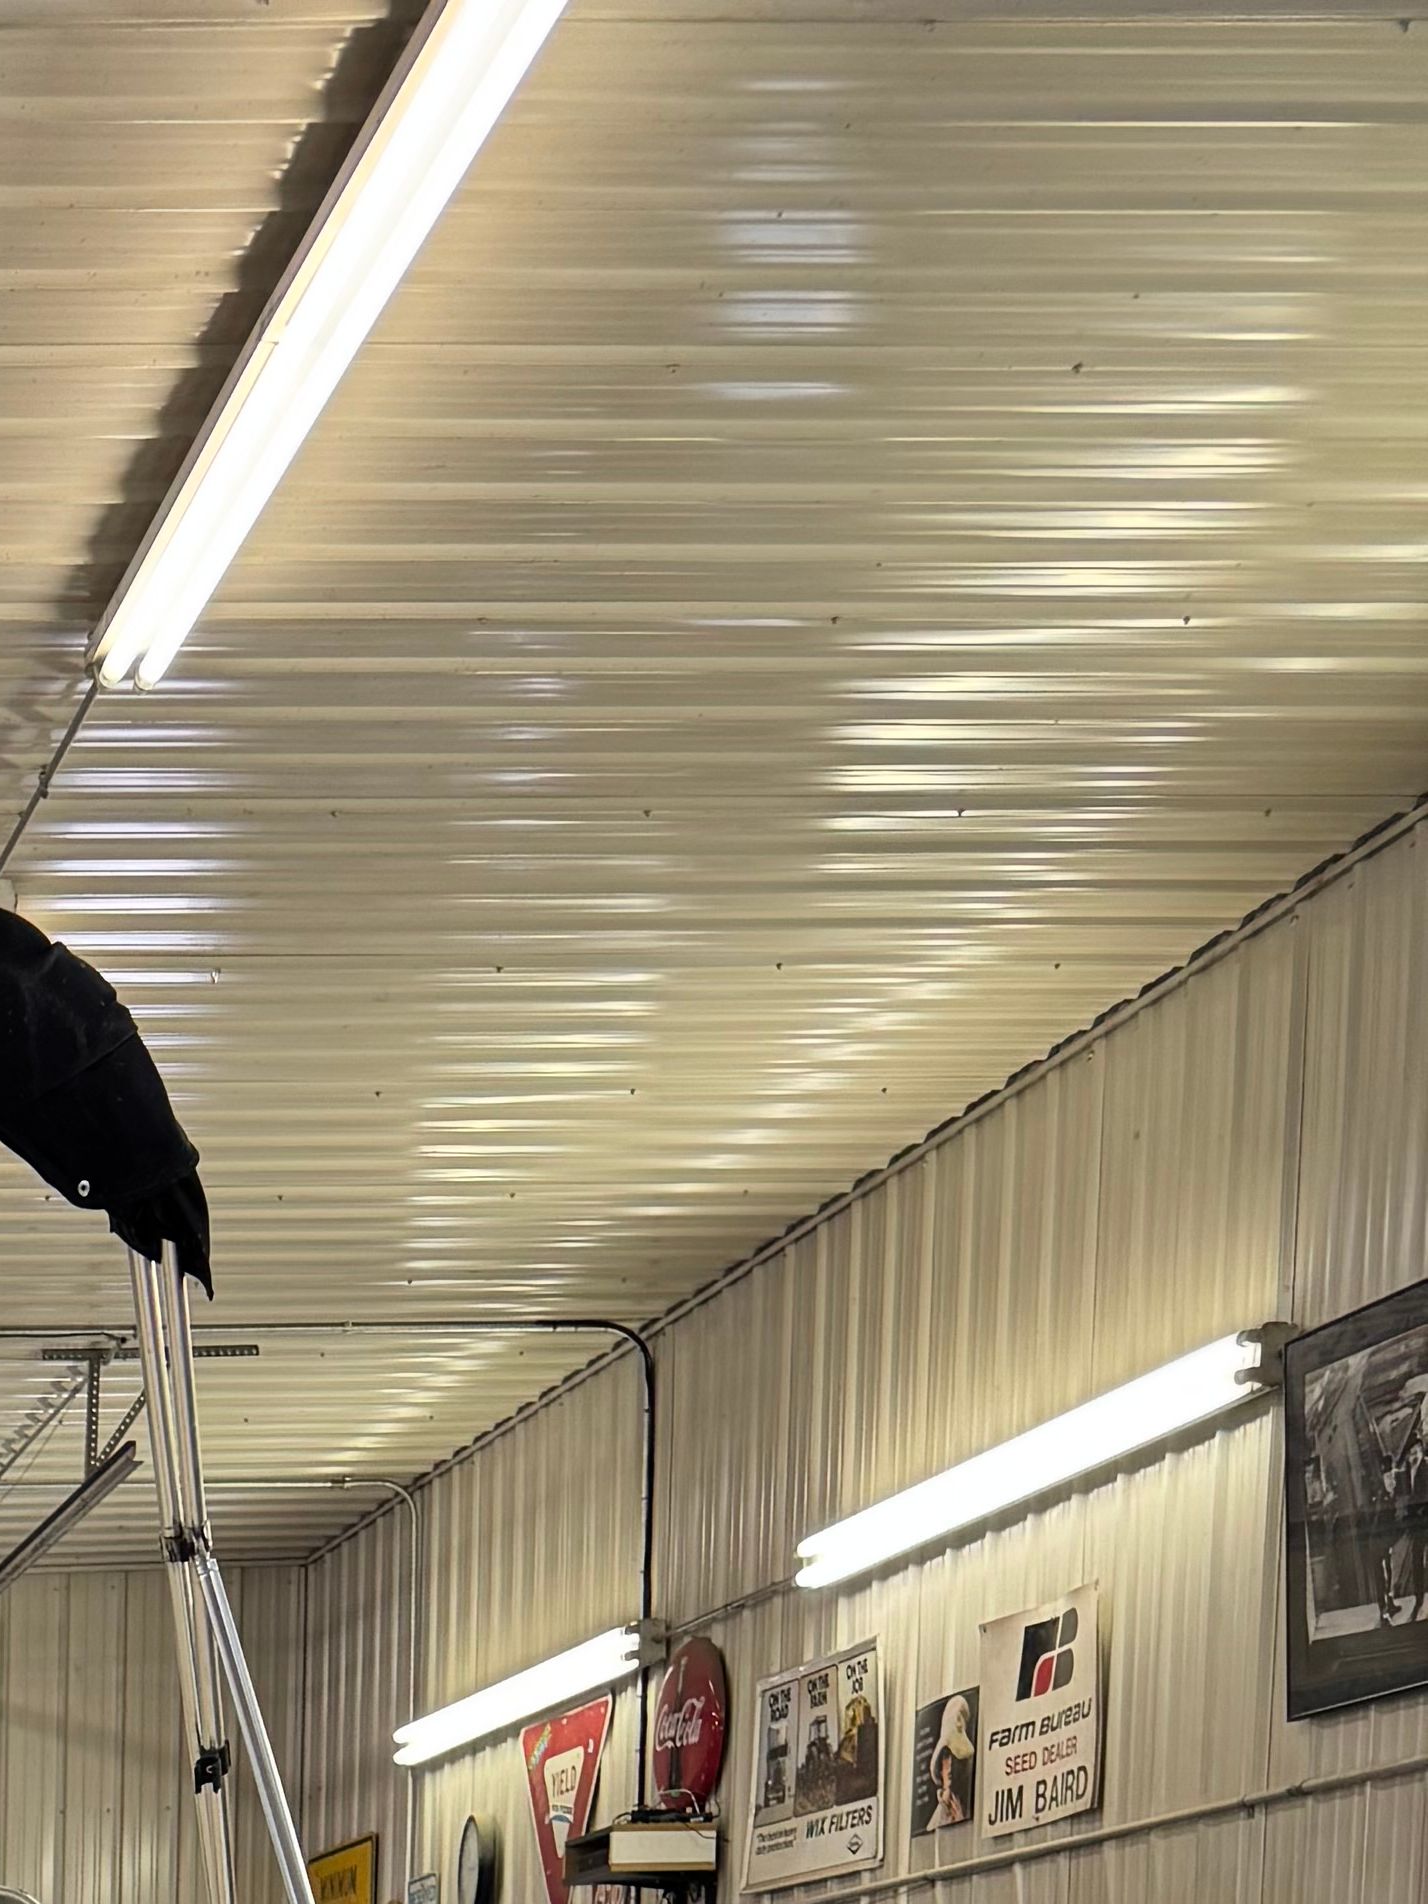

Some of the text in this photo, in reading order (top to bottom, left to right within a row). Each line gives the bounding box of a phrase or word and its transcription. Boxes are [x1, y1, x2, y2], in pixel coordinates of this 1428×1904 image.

[1005, 1735, 1078, 1776] SEED DEALER
[551, 1764, 576, 1798] YIELD
[988, 1765, 1088, 1826] JIM BAIRD
[828, 1804, 873, 1834] FILTERS
